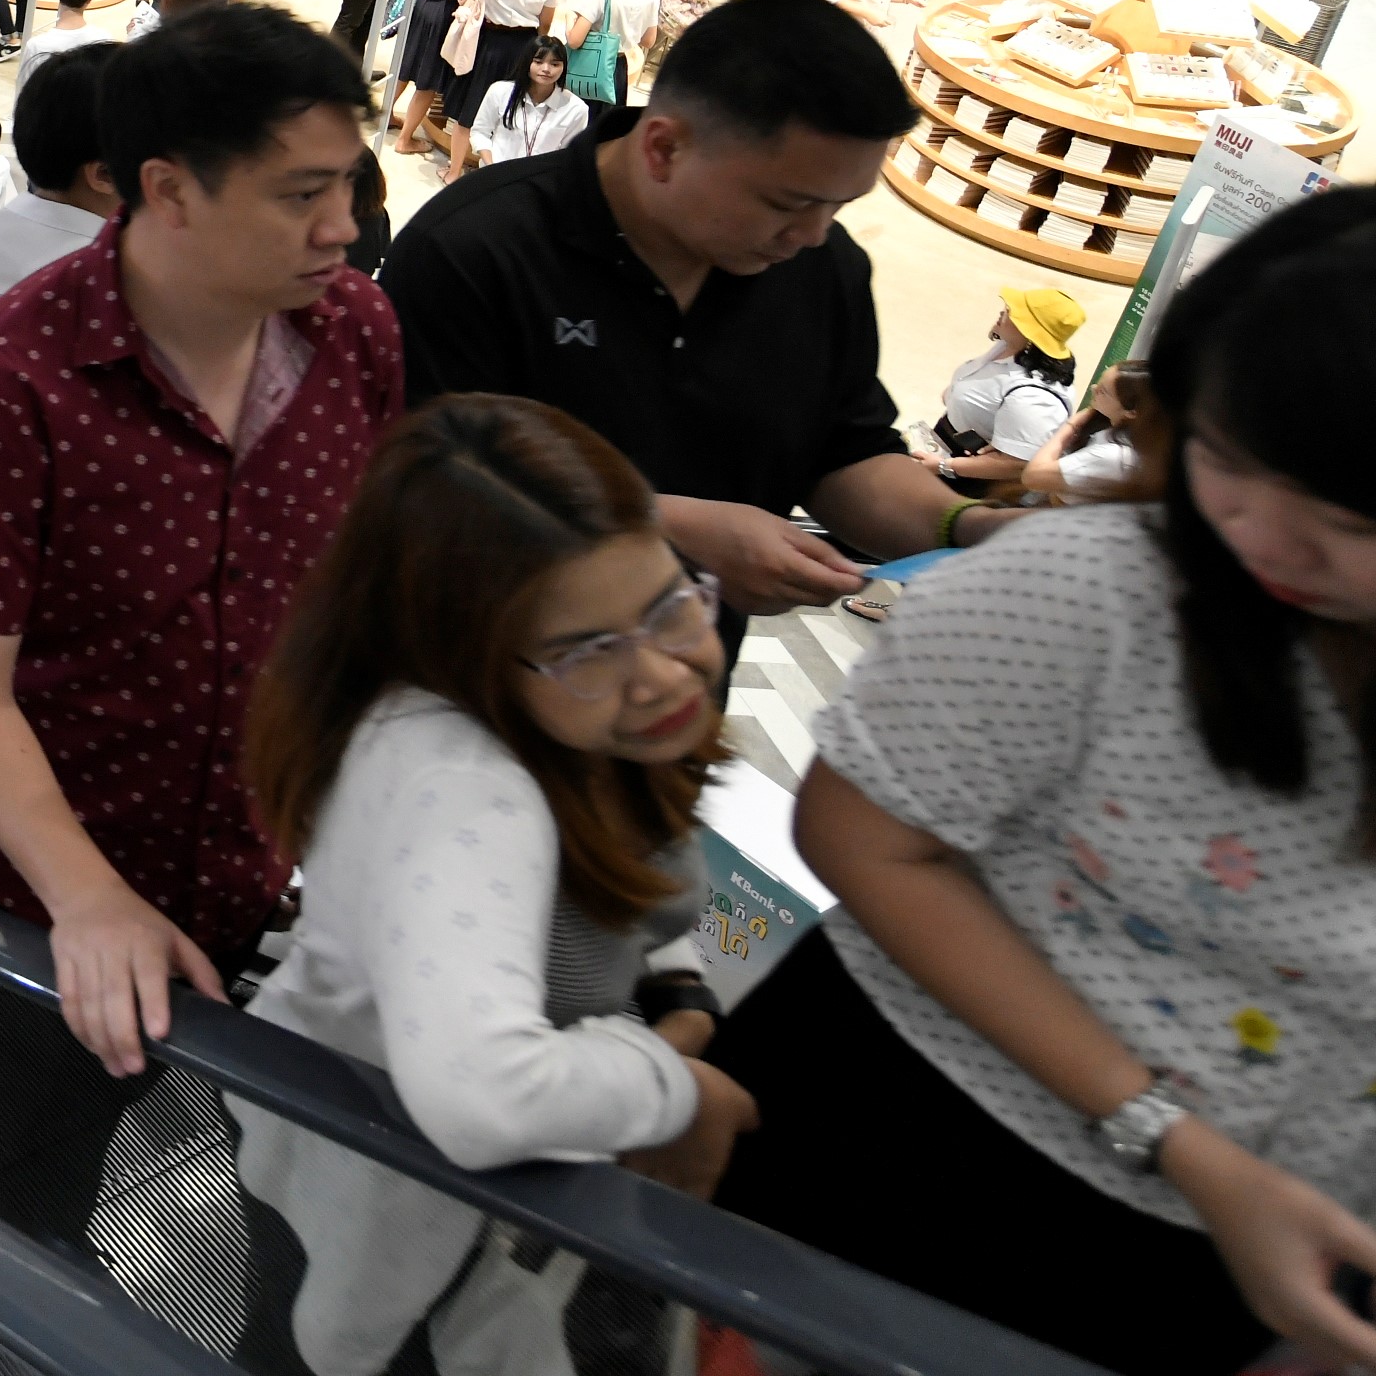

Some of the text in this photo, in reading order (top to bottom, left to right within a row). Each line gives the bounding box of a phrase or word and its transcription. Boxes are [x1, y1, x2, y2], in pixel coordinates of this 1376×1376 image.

[1216, 124, 1254, 153] MUJI
[1214, 139, 1244, 160] 無印良品
[1254, 181, 1276, 200] Cash
[1245, 192, 1272, 213] 200
[730, 871, 776, 913] KBank
